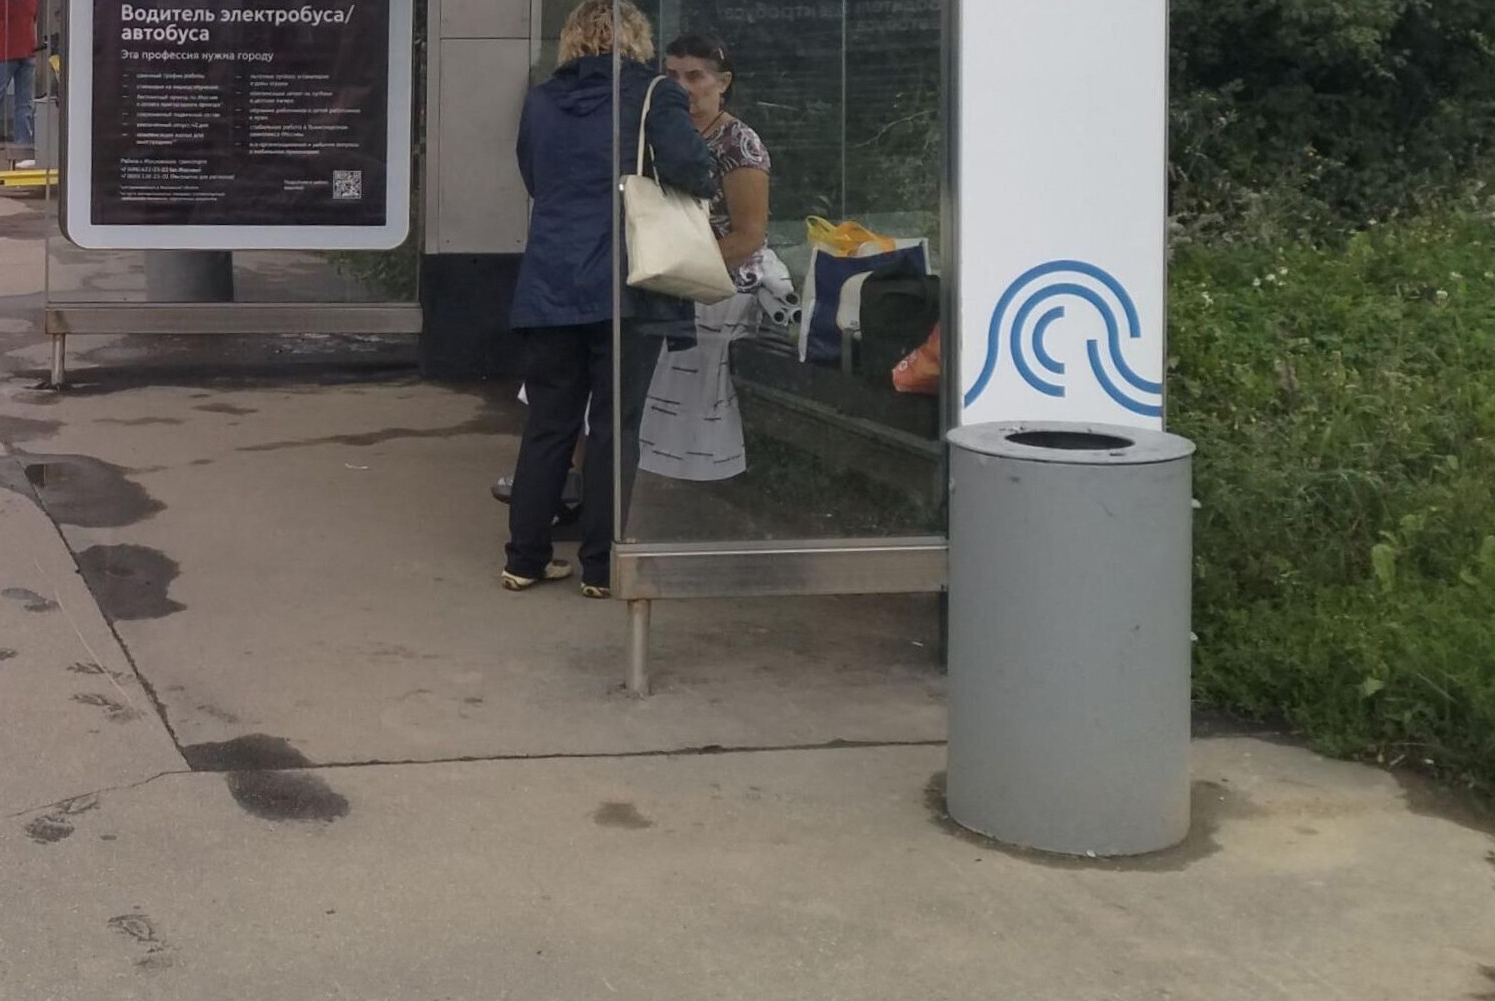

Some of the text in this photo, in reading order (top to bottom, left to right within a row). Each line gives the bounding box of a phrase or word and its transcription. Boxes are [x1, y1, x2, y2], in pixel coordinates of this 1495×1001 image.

[120, 3, 355, 27] Водитель электробуса/
[120, 24, 210, 45] автобуса
[120, 50, 275, 63] Эта профессия нужна городу
